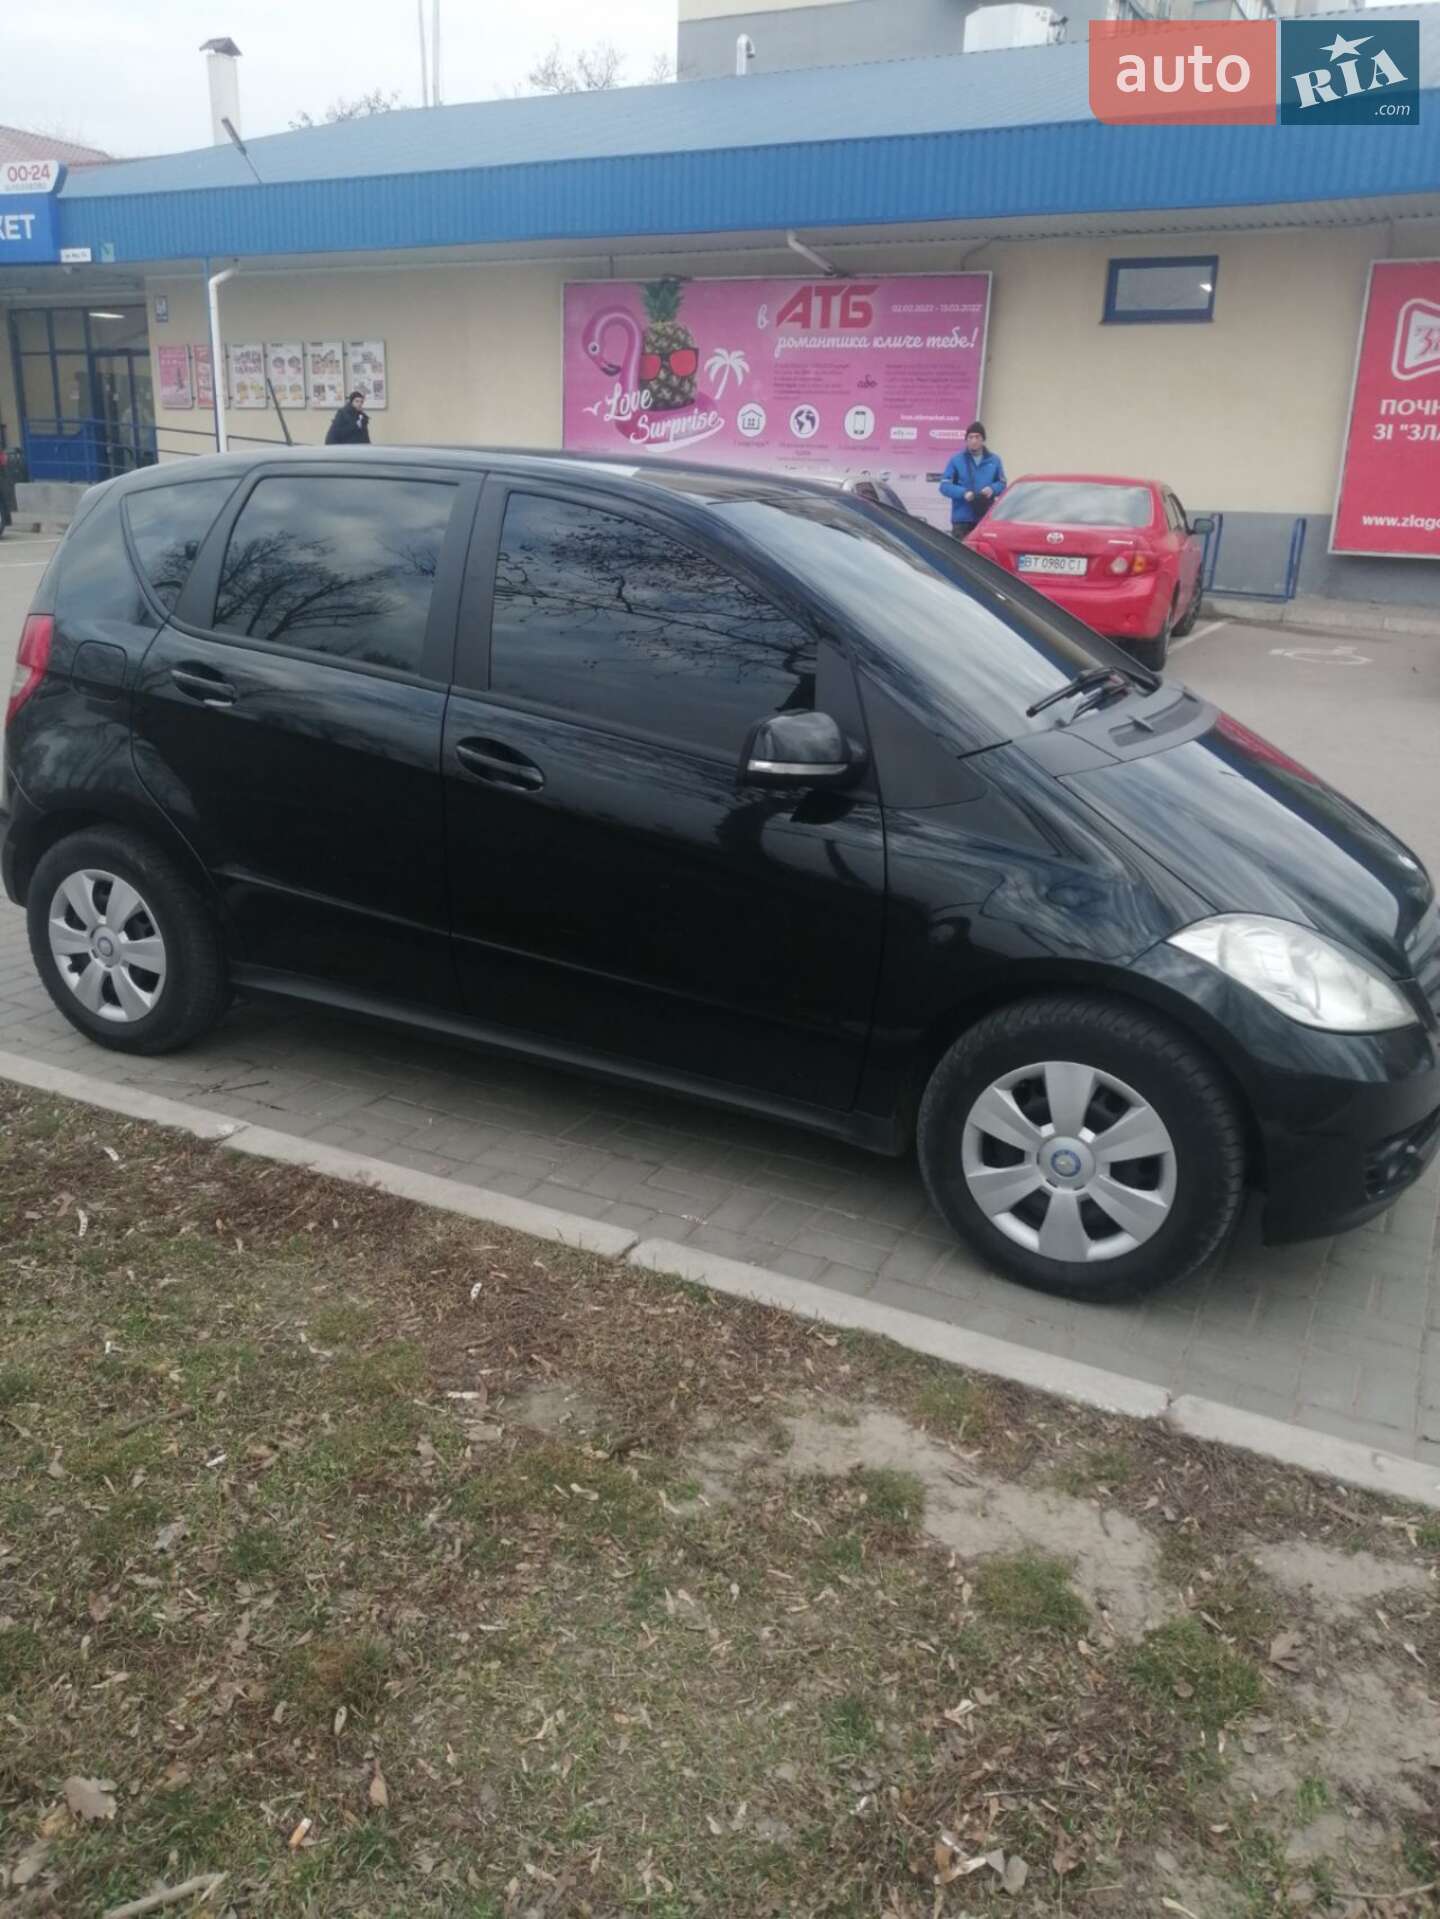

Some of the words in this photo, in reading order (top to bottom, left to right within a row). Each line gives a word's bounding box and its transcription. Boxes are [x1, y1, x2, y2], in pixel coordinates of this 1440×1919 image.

[756, 303, 769, 330] в
[775, 284, 880, 330] АТБ
[774, 334, 871, 359] романтика
[872, 335, 923, 349] кличе
[926, 326, 979, 349] тебе!
[604, 382, 652, 421] Love
[630, 407, 724, 446] Surprise
[1399, 423, 1440, 441] "ЗЛ
